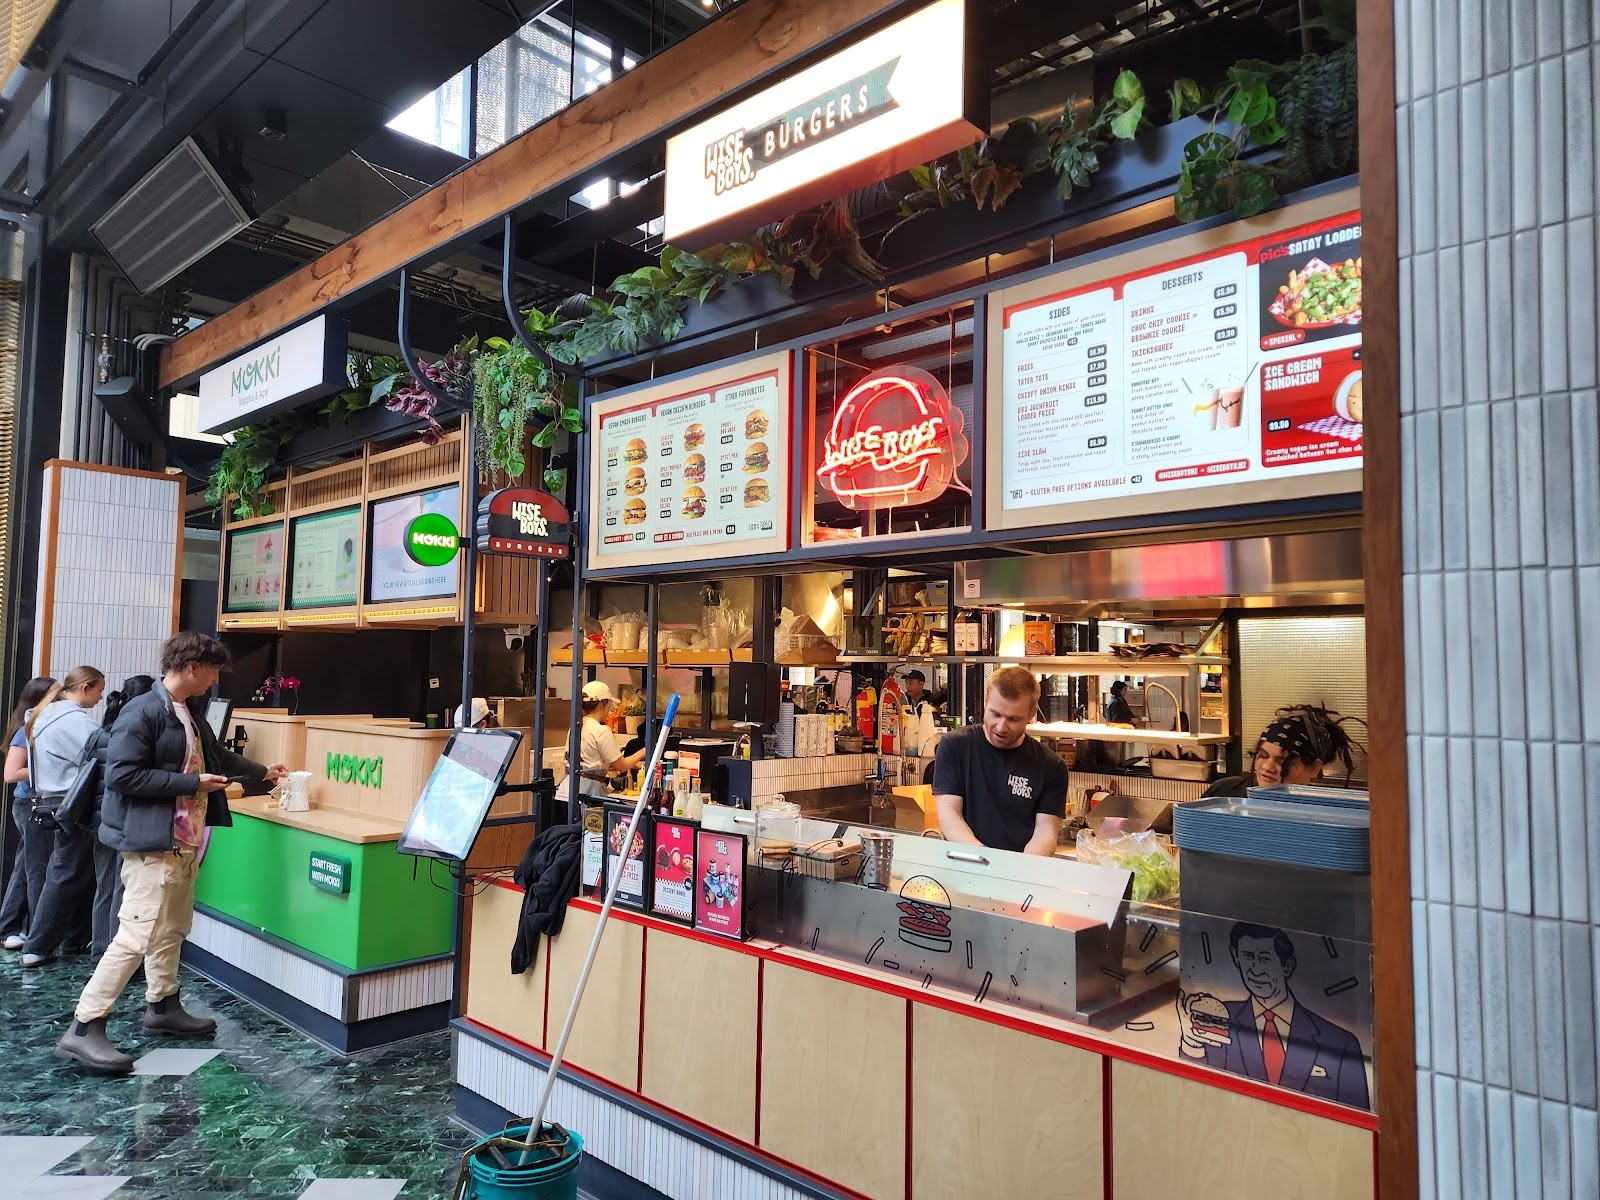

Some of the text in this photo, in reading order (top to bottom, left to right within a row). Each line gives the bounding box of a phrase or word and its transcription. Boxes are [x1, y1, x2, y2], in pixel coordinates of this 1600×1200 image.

[764, 84, 868, 157] BURGERS
[706, 129, 746, 177] WISE
[1288, 236, 1322, 256] SATAY
[1325, 226, 1362, 246] LOADE
[1162, 271, 1203, 290] DESSERTS
[1216, 285, 1234, 296] $5.90
[1049, 306, 1070, 319] SIDES
[1131, 306, 1154, 317] DRINKS
[1131, 322, 1146, 333] CHOC
[1149, 319, 1164, 329] CHIP
[1166, 312, 1190, 324] COOKIE
[1131, 324, 1185, 343] BROWNIE COOKIE
[1269, 333, 1296, 345] SPECIAL
[1132, 342, 1173, 358] THICKSHAKES
[1154, 353, 1172, 362] creamy
[1018, 363, 1034, 372] FRIES
[1265, 357, 1322, 379] ICE CREAM
[1018, 376, 1033, 386] TATER
[1264, 370, 1320, 391] SANDWICH
[725, 385, 765, 401] OTHER FAVOURITES
[1018, 382, 1076, 400] CRISPY ONION RINGS
[238, 394, 254, 407] Matcha
[1030, 400, 1059, 411] JACKFRUIT
[661, 408, 672, 416] VEGAN
[689, 400, 705, 410] BURGERS
[1018, 408, 1055, 421] LOADED FRIES
[1268, 420, 1290, 430] $9.50
[825, 417, 943, 466] WISE BOYS
[1018, 447, 1047, 458] SIDE SLAW
[1266, 452, 1298, 462] sandwiched
[1299, 450, 1324, 458] between
[1158, 468, 1198, 479] @WISEBOYSNZ
[1030, 487, 1050, 496] GLUTEN
[1052, 485, 1065, 493] FREE
[1067, 482, 1091, 492] OPTIONS
[1094, 476, 1127, 488] AVAILABLE
[512, 501, 542, 521] WISE
[496, 541, 562, 555] BURGERS
[1008, 774, 1029, 788] WISE
[312, 857, 342, 875] START FRESH
[312, 870, 324, 883] WITH
